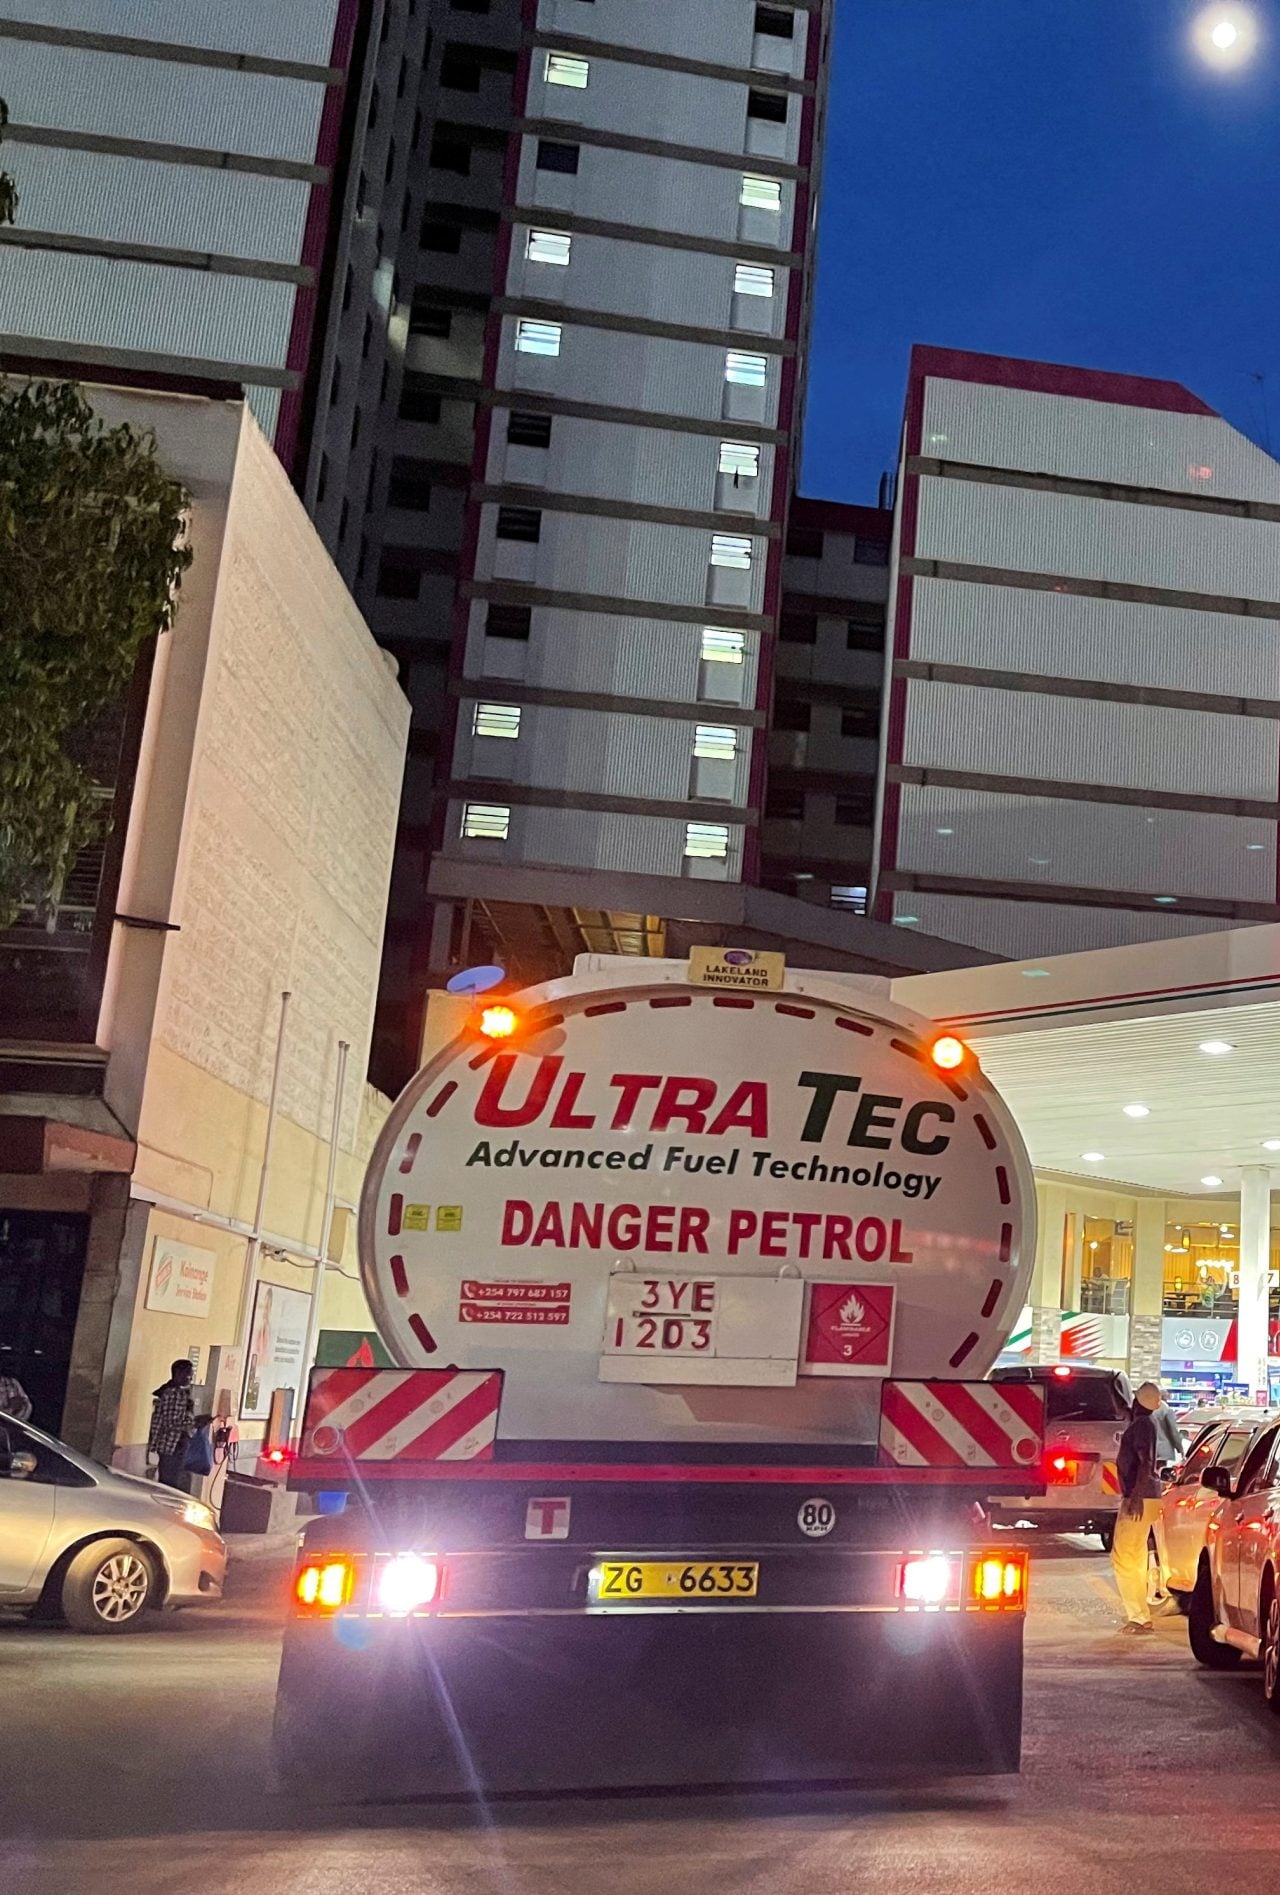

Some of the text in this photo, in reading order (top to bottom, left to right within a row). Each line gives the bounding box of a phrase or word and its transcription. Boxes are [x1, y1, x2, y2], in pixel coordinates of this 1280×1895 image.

[703, 974, 769, 987] INNOVATOR
[706, 965, 768, 977] LAKELAND
[474, 1054, 956, 1156] ULTRA TEC
[465, 1139, 942, 1200] Advanced Fuel Technology
[501, 1199, 710, 1254] DANGER
[727, 1209, 914, 1264] PETROL
[1233, 1274, 1240, 1285] 8
[1267, 1272, 1275, 1284] 7
[507, 1288, 526, 1298] 797
[550, 1290, 569, 1298] 157
[640, 1280, 716, 1311] 3YE
[505, 1311, 523, 1320] 722
[547, 1313, 567, 1321] 597
[614, 1318, 713, 1350] 1203
[842, 1344, 853, 1357] 3
[532, 1501, 567, 1534] T
[803, 1504, 832, 1526] 80
[604, 1566, 755, 1593] ZG 6633
